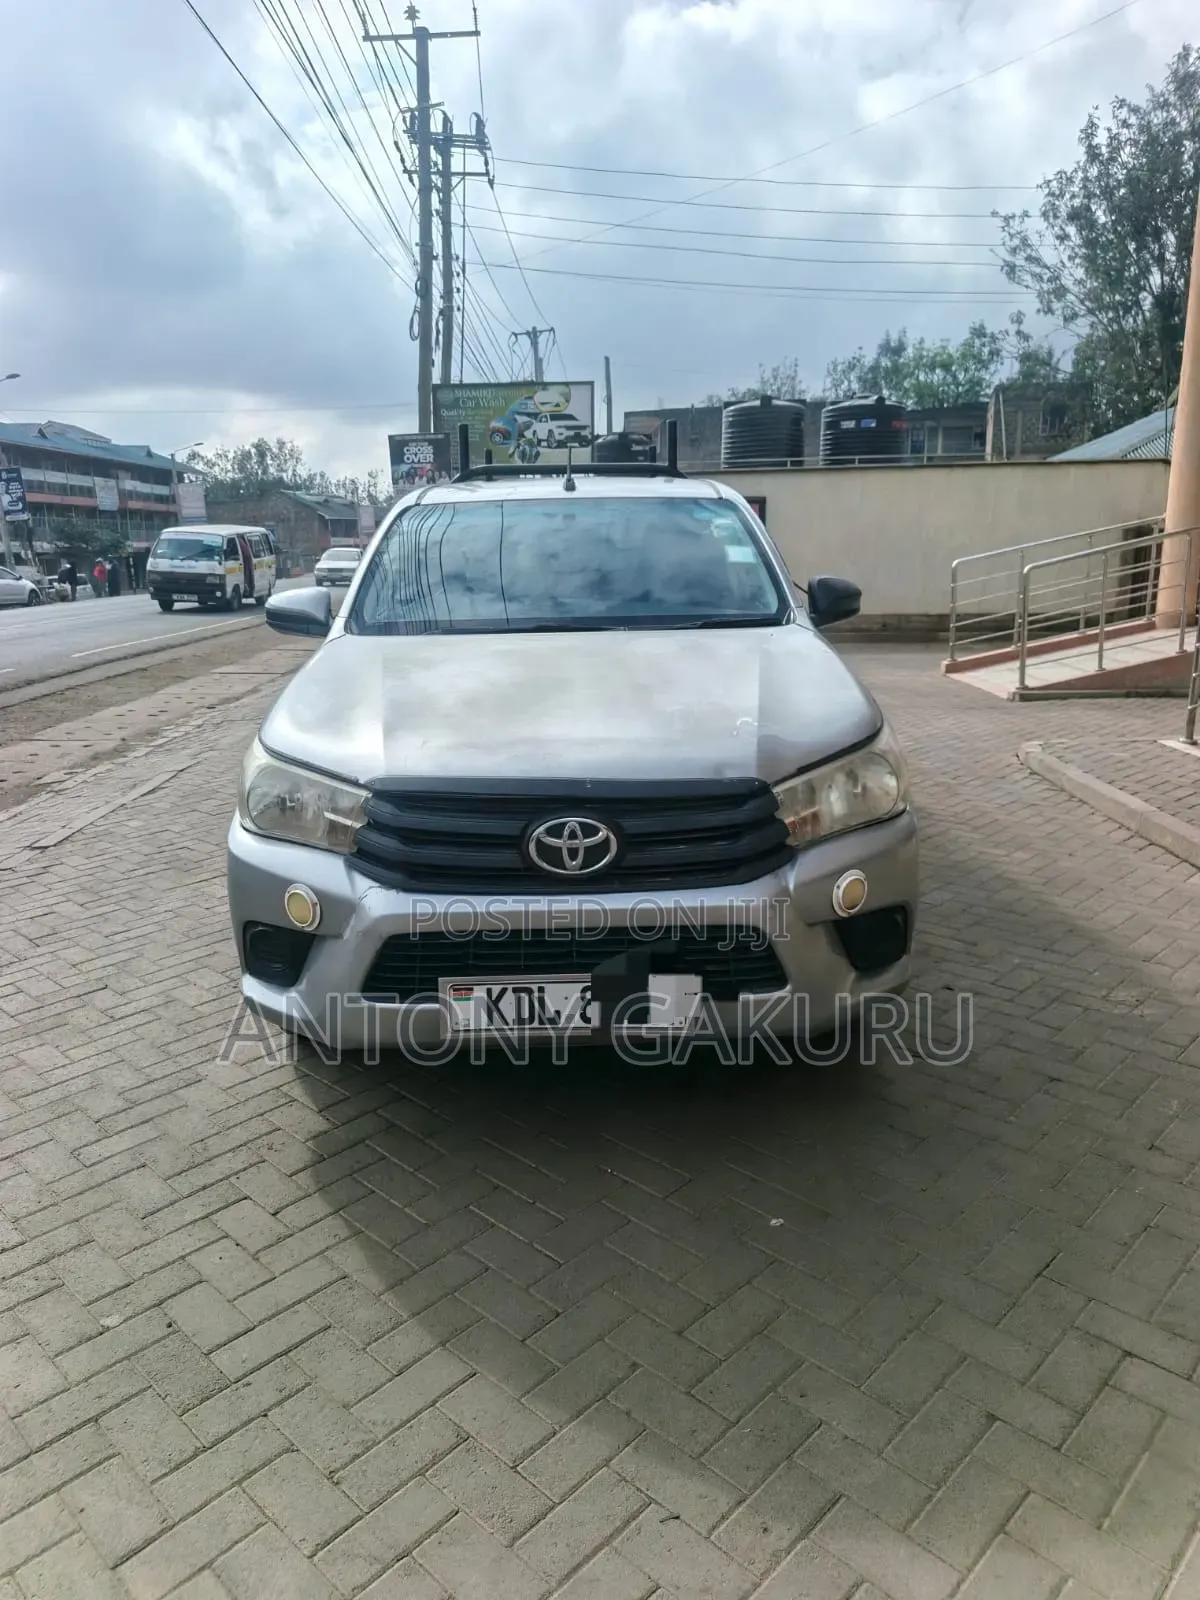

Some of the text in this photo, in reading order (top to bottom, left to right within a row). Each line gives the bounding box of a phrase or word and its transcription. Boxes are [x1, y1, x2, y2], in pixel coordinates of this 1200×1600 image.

[459, 396, 506, 407] Car Wash
[403, 446, 434, 454] CROSS
[403, 454, 434, 463] OVER
[485, 985, 562, 1027] KDL
